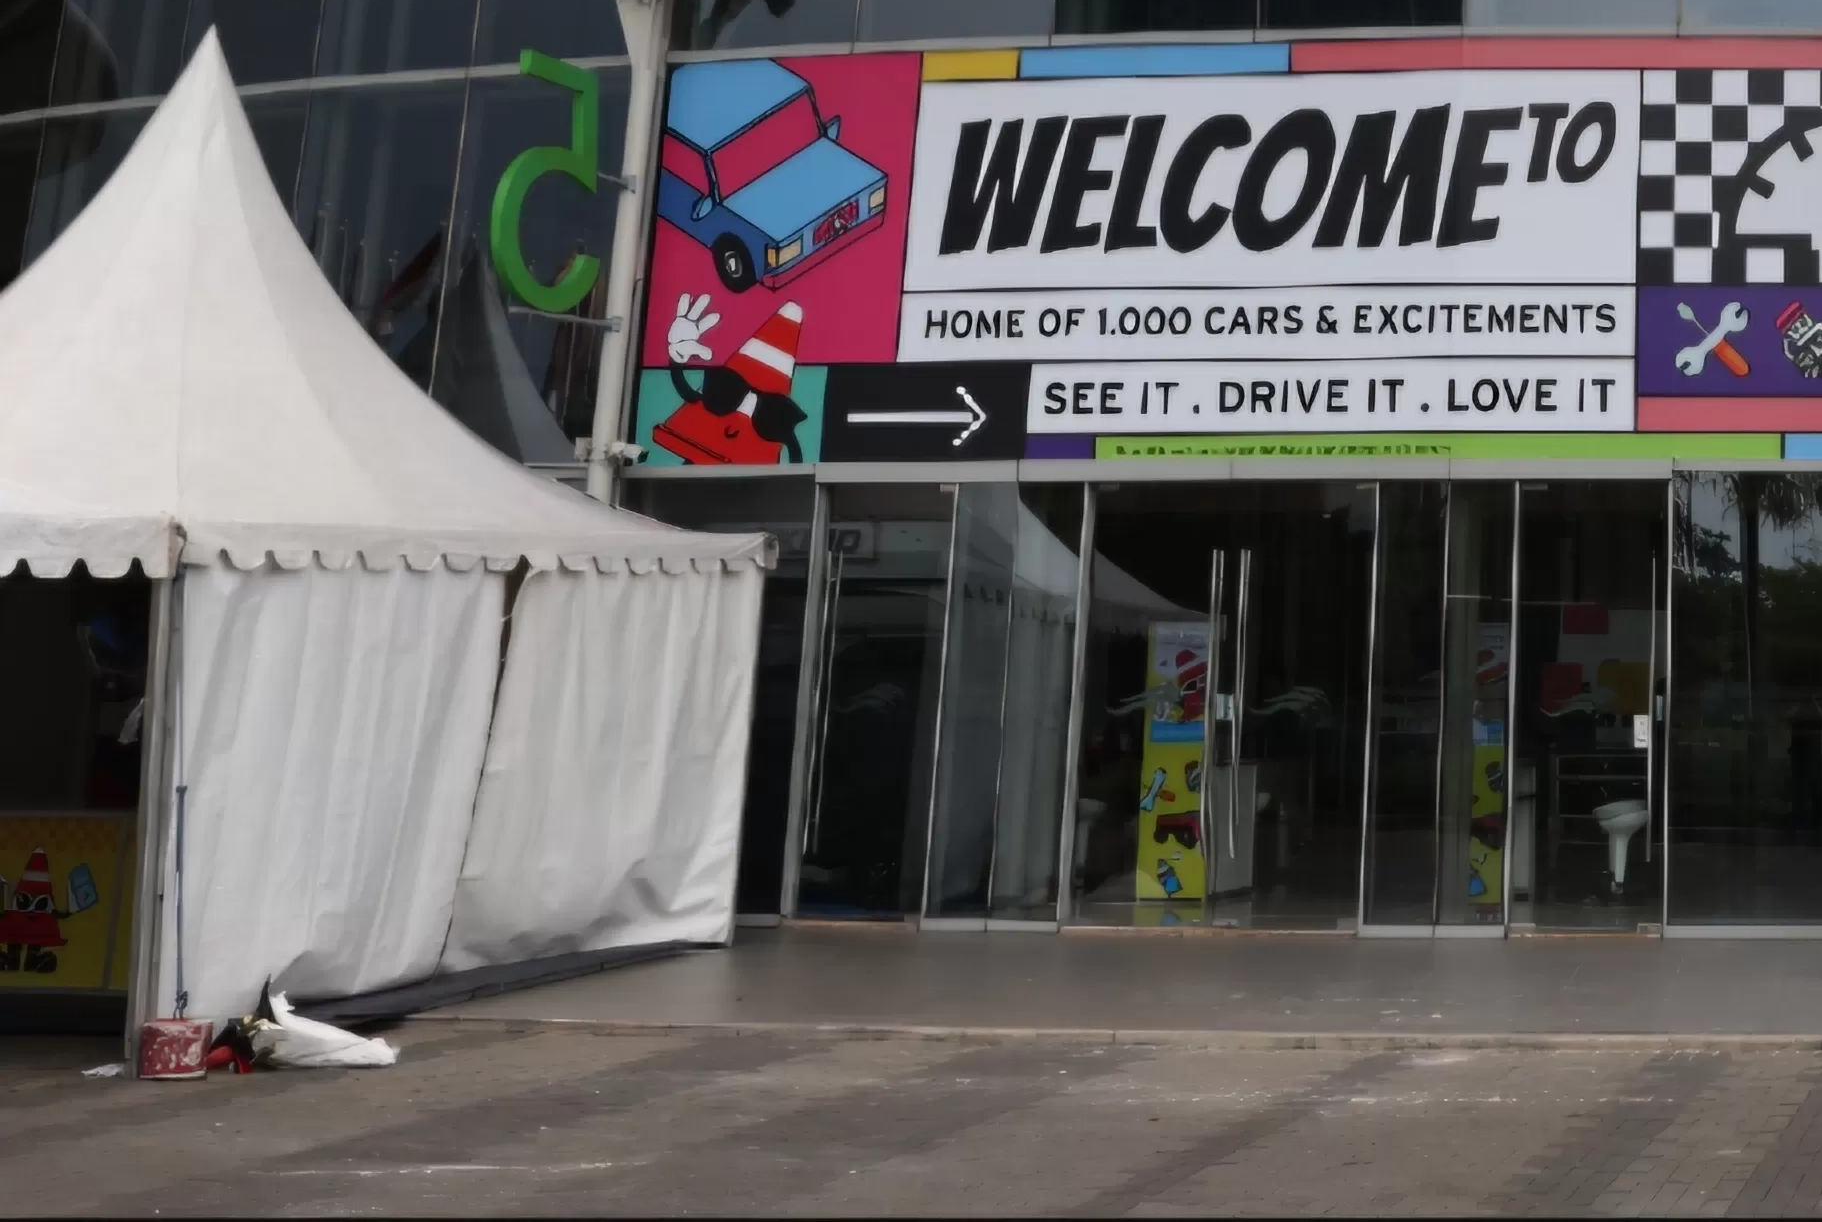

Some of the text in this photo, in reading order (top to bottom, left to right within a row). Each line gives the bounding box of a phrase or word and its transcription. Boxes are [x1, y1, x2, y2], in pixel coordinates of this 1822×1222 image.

[939, 101, 1617, 256] WELCOME TO
[925, 304, 1617, 340] HOME OF 1.000 CARS & EXCITEMENTS
[1045, 382, 1125, 416] SEE
[1219, 380, 1350, 415] DRIVE
[1448, 379, 1559, 414] LOVE
[1579, 379, 1617, 414] IT
